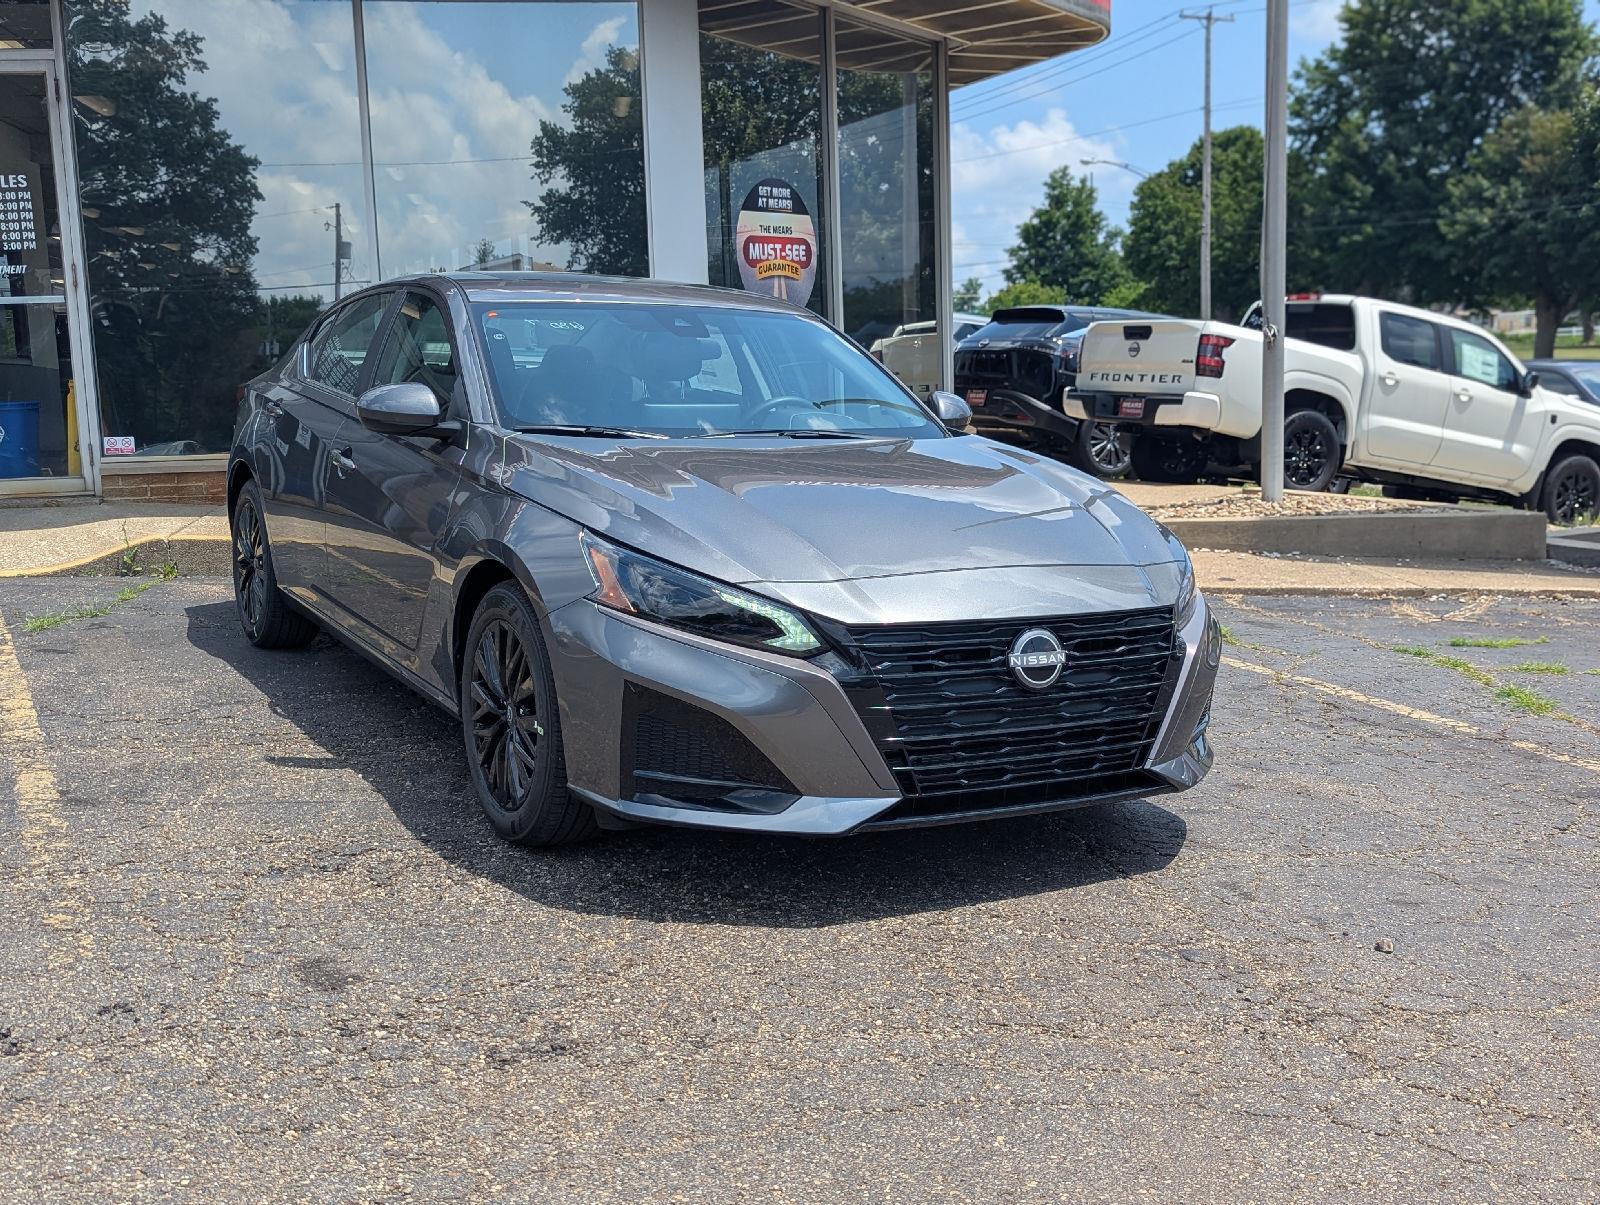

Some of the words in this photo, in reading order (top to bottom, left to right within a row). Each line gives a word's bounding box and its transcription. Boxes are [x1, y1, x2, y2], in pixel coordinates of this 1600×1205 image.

[18, 191, 31, 200] PM
[758, 186, 772, 196] GET
[772, 187, 791, 198] MORE
[20, 201, 32, 210] PM
[758, 198, 768, 208] AT
[768, 199, 792, 210] MEARS!
[20, 211, 33, 220] PM
[1, 221, 19, 230] 8:00
[21, 221, 34, 230] PM
[759, 224, 772, 234] THE
[772, 226, 793, 235] MEARS
[2, 231, 21, 240] 6:00
[22, 231, 36, 240] PM
[23, 241, 37, 250] PM
[749, 243, 807, 261] MUST-SEE
[758, 263, 800, 276] GUARANTEE
[1090, 372, 1182, 384] FRONTIER
[1010, 652, 1065, 666] NISSAN
